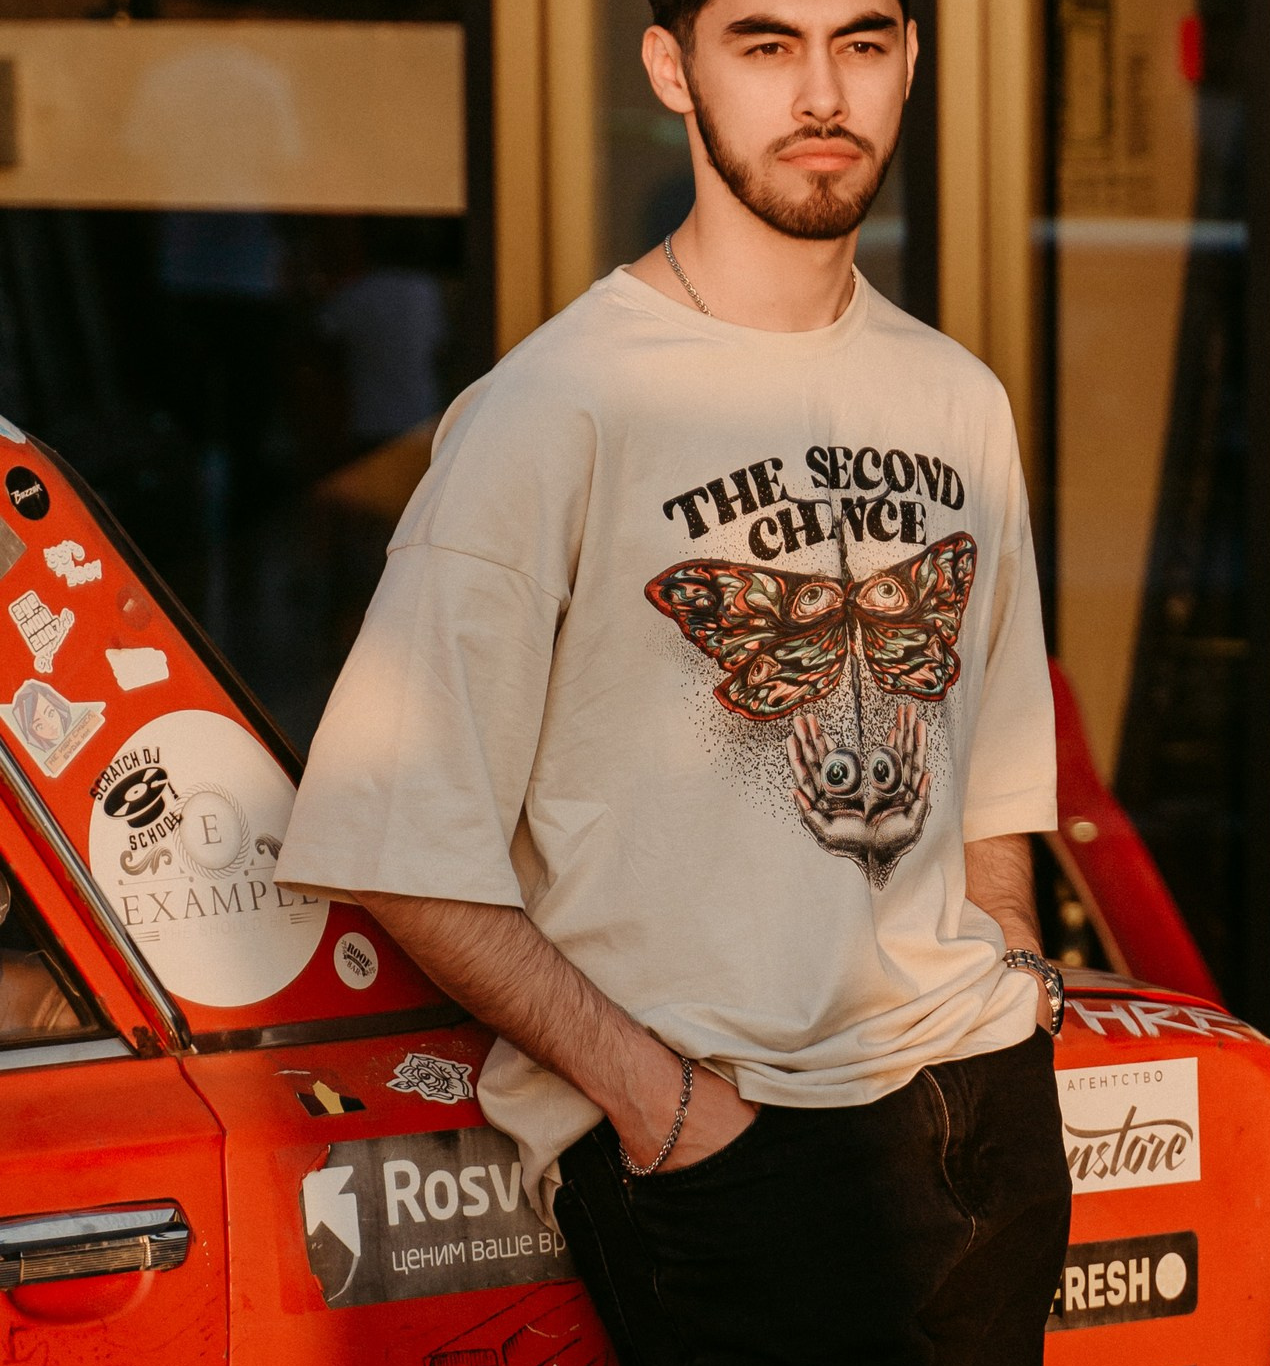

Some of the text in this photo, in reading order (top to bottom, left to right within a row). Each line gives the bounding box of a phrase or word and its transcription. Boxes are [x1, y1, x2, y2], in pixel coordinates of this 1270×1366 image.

[662, 445, 965, 539] THE SECOND
[89, 747, 160, 802] SCRATCH DJ
[129, 811, 184, 851] SCHOOL
[200, 814, 222, 846] E
[346, 960, 361, 976] BAR
[347, 942, 373, 968] ROOF
[1056, 999, 1250, 1043] HRE
[1067, 1069, 1164, 1092] АГЕНТСТВО
[391, 1241, 466, 1275] ценим
[471, 1234, 534, 1262] ваше
